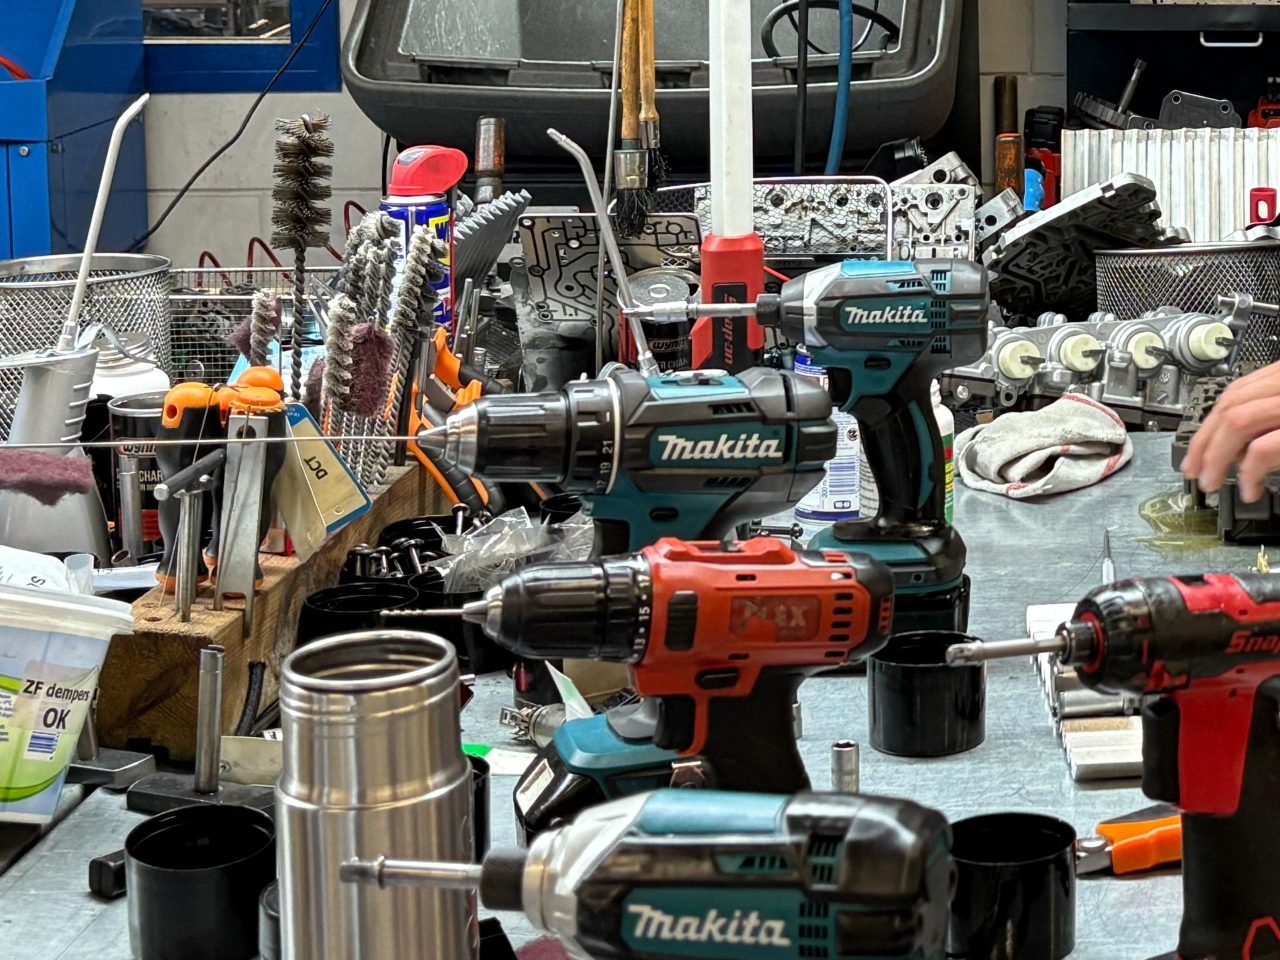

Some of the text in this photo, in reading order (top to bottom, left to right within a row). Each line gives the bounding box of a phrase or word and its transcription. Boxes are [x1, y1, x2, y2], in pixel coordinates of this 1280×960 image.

[844, 305, 929, 325] Makita
[657, 432, 784, 461] Makita
[303, 455, 329, 481] DCT
[23, 679, 91, 704] ZF dempers
[43, 707, 71, 730] OK
[626, 903, 792, 948] Makita
